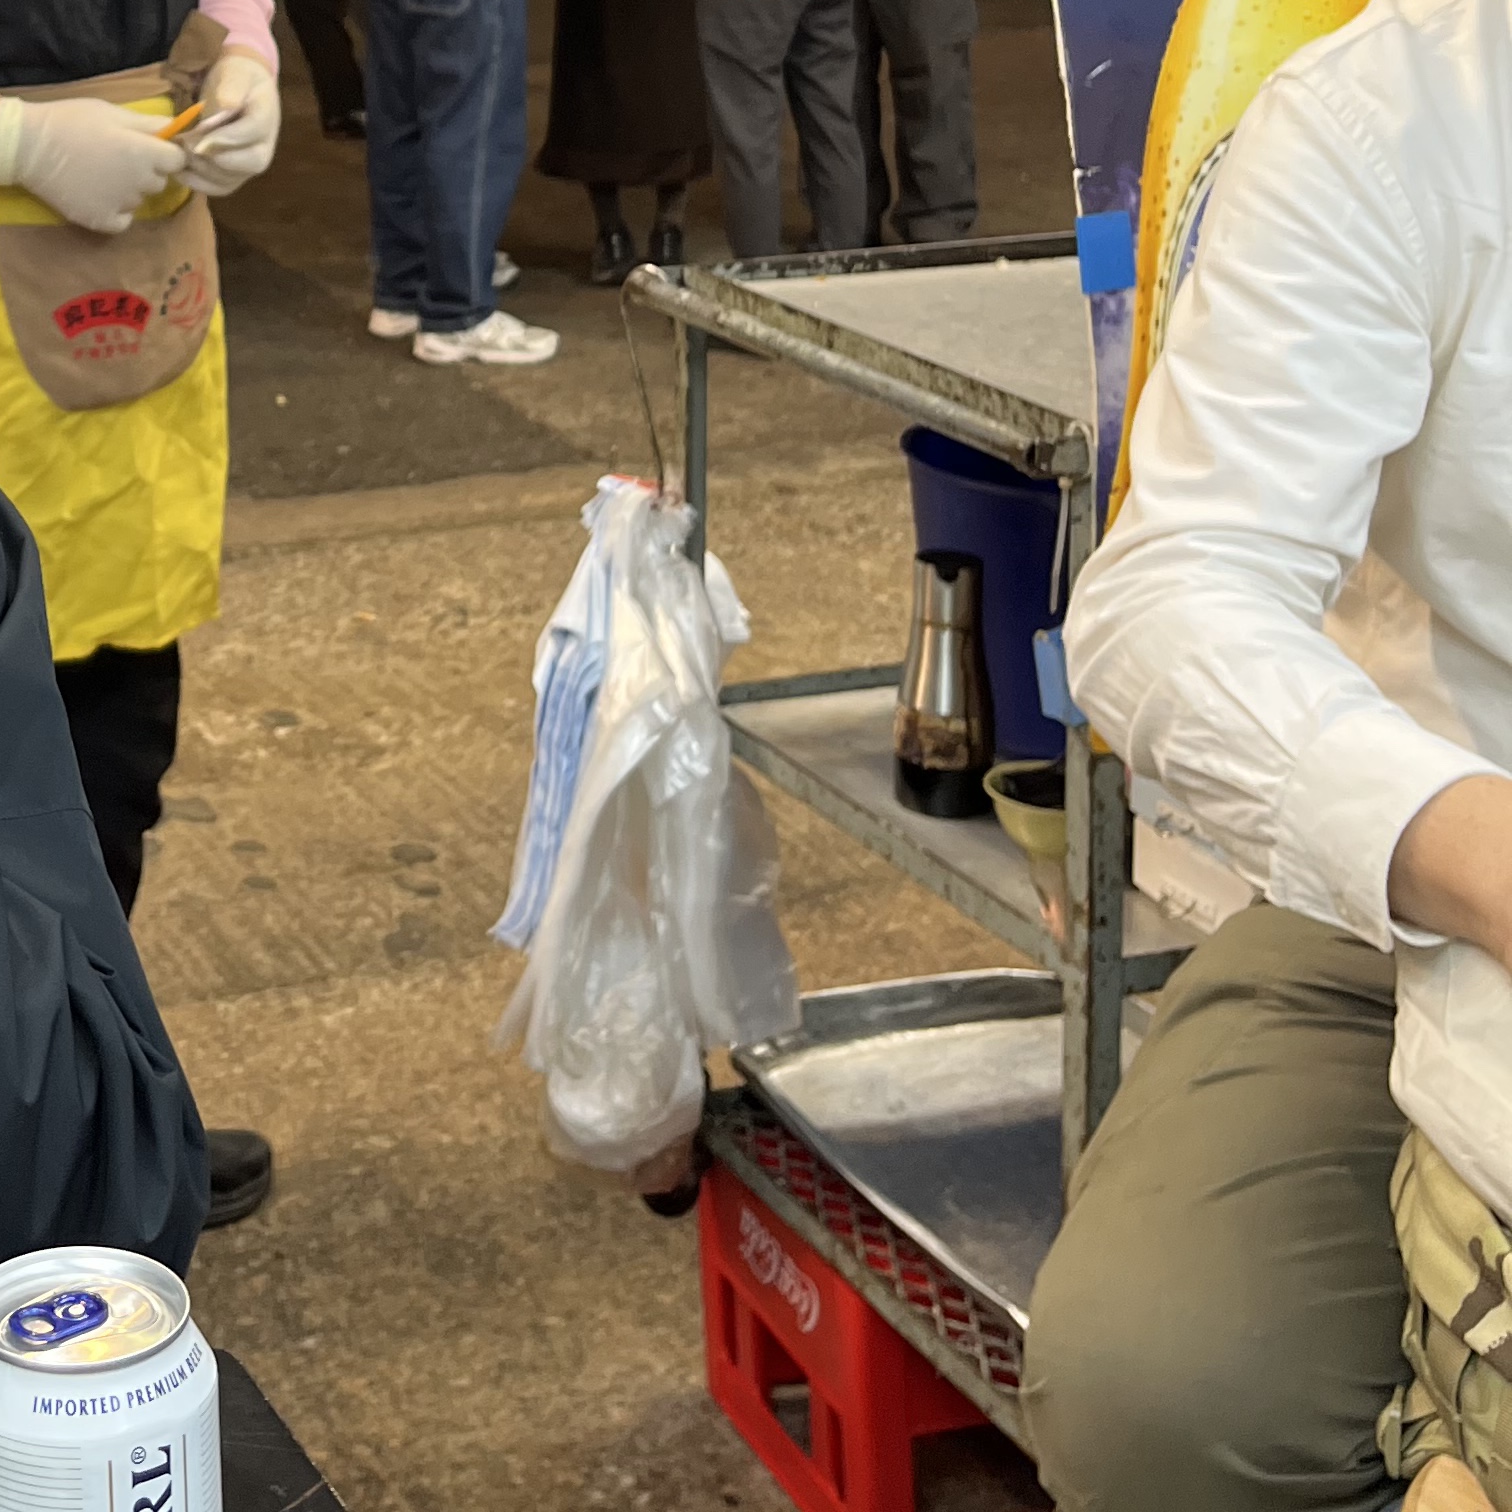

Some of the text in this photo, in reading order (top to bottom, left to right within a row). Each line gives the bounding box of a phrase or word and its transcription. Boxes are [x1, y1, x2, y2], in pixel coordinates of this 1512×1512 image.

[32, 1342, 204, 1416] IMPORTED PREMIUM BEER
